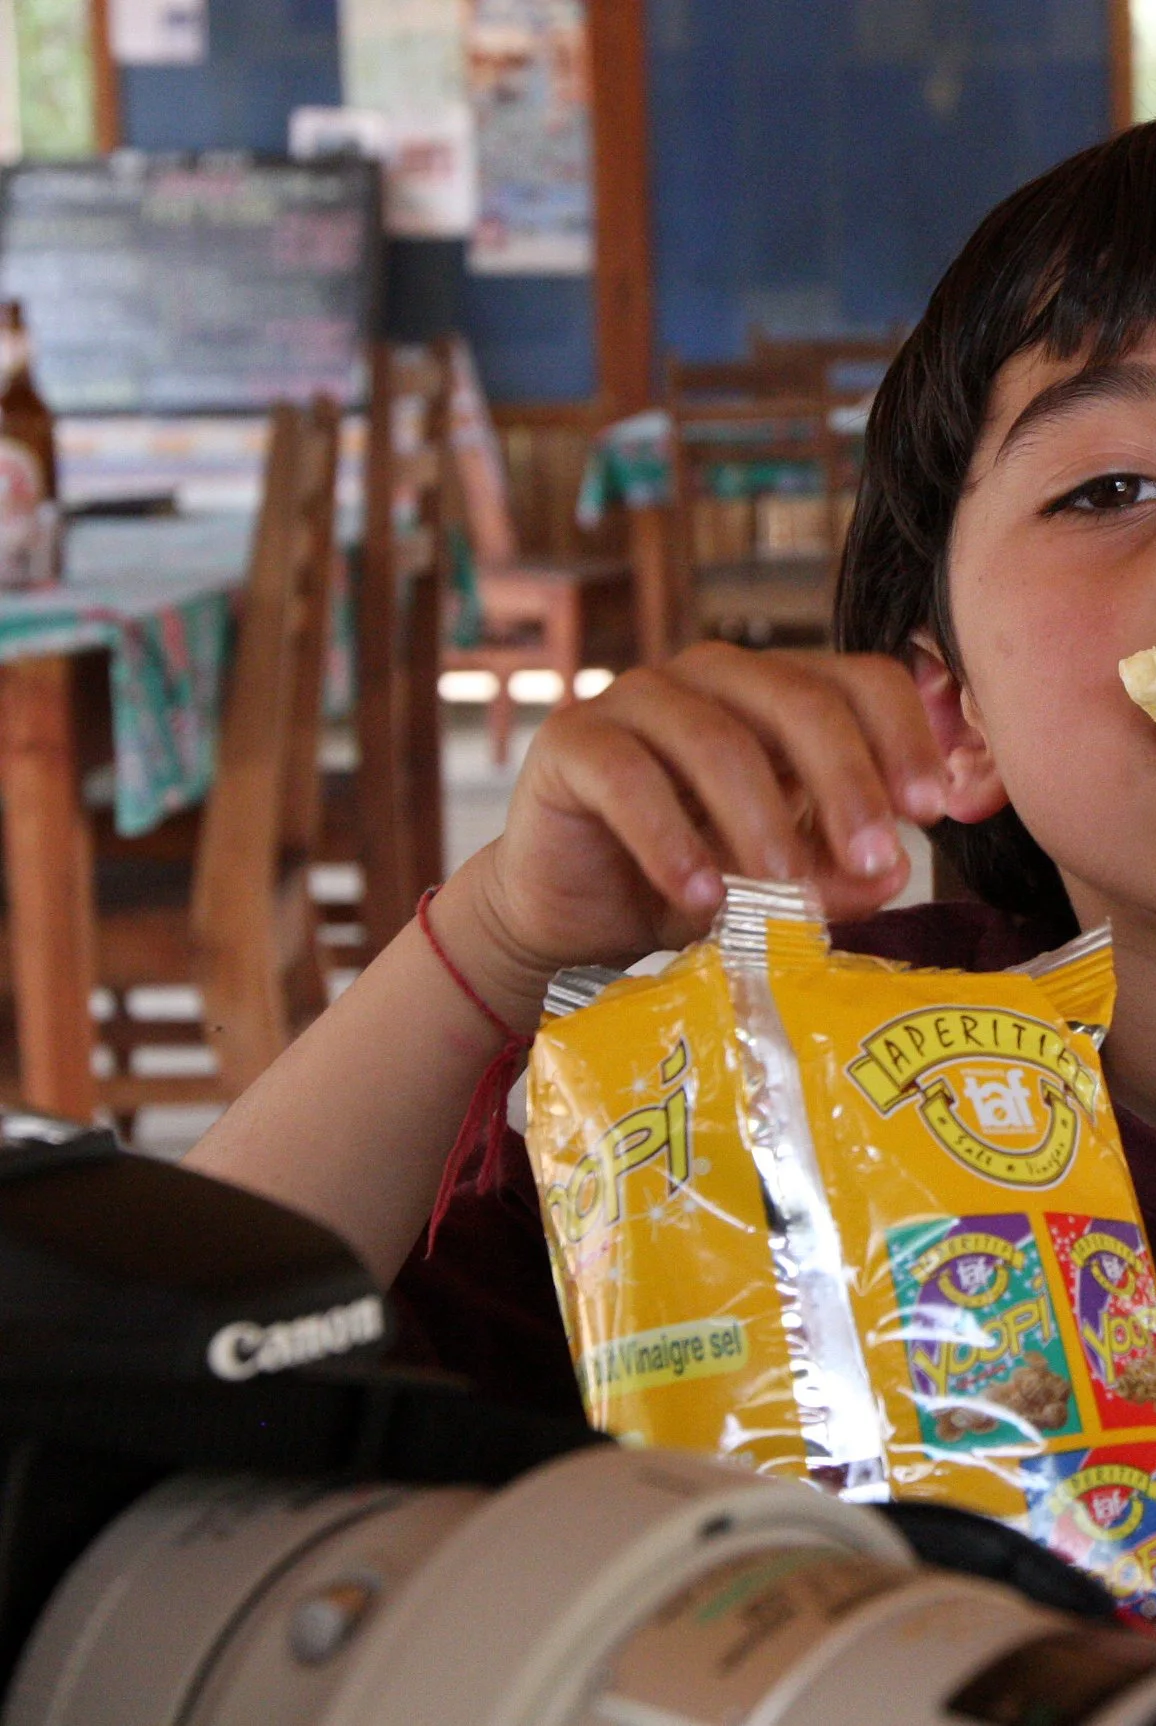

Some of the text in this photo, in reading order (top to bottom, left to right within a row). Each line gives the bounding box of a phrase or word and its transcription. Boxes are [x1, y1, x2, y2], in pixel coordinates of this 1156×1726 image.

[963, 1069, 1034, 1127] taf
[207, 1296, 384, 1381] Canon
[709, 1319, 743, 1359] sel
